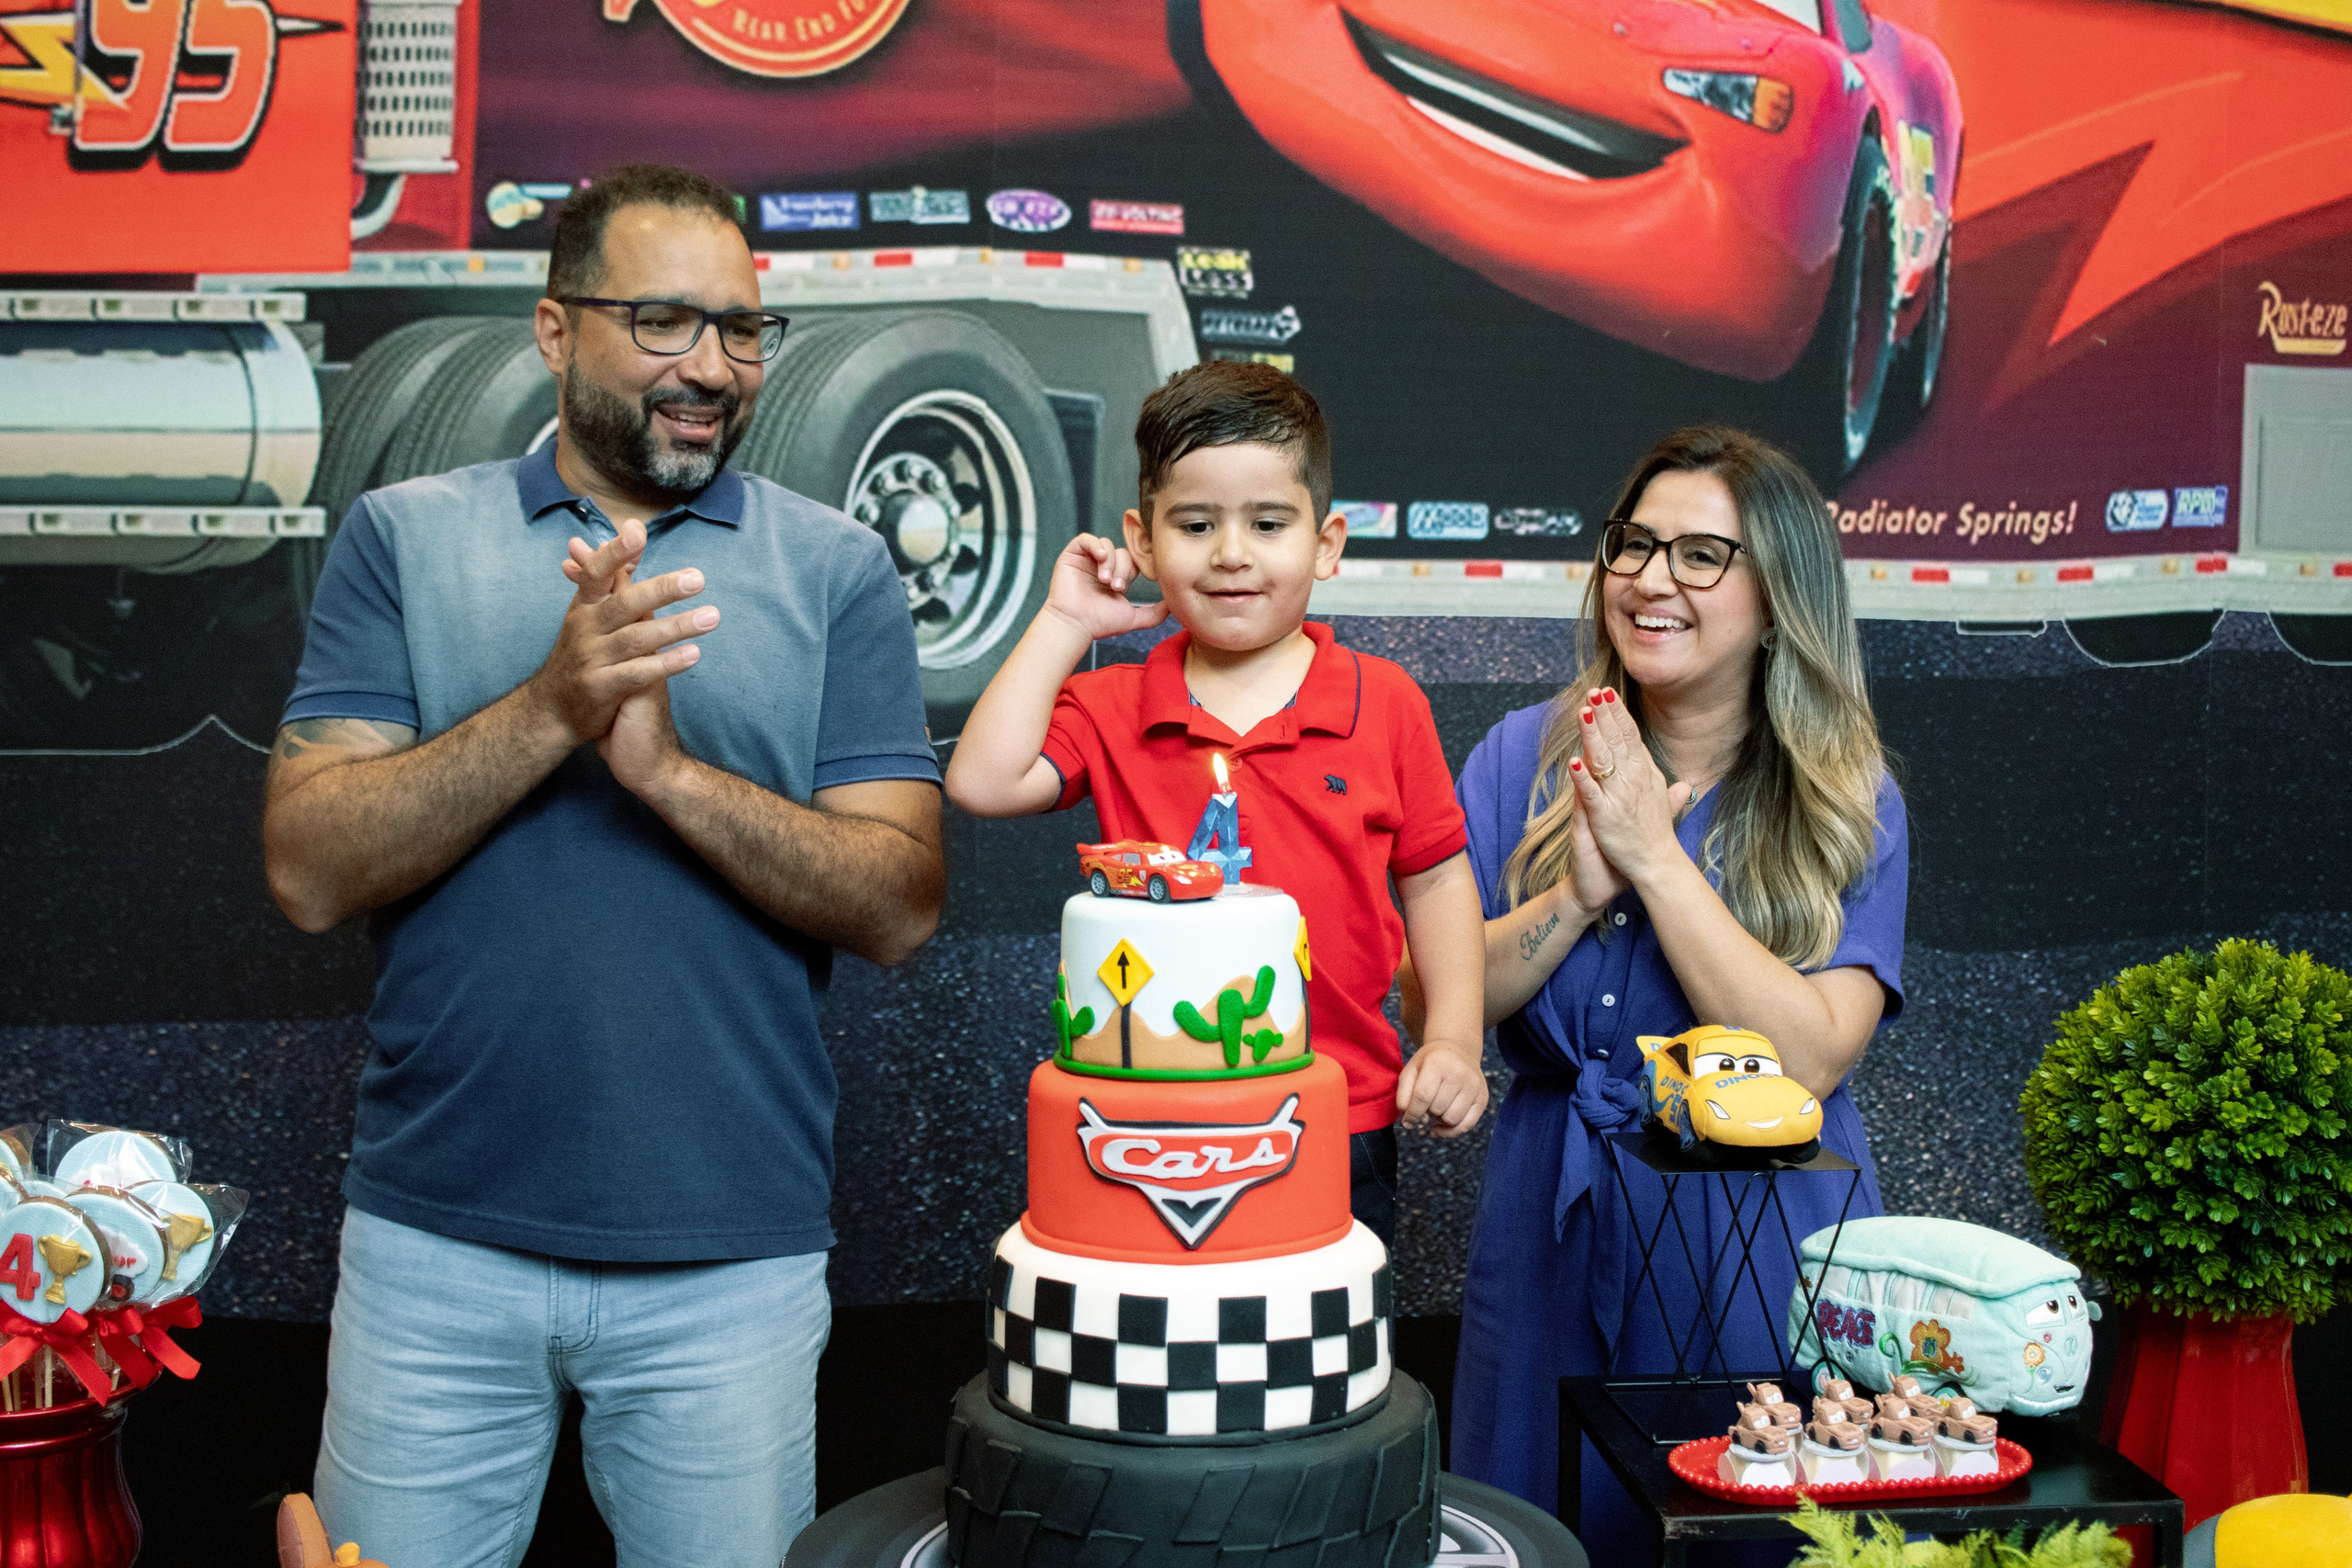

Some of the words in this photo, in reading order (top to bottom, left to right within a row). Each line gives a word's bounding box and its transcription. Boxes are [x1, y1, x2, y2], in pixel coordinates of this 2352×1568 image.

[732, 8, 786, 42] REAR
[794, 12, 837, 42] END
[1956, 501, 2078, 545] Springs!
[1102, 1137, 1286, 1179] Cars
[0, 1233, 41, 1301] 4
